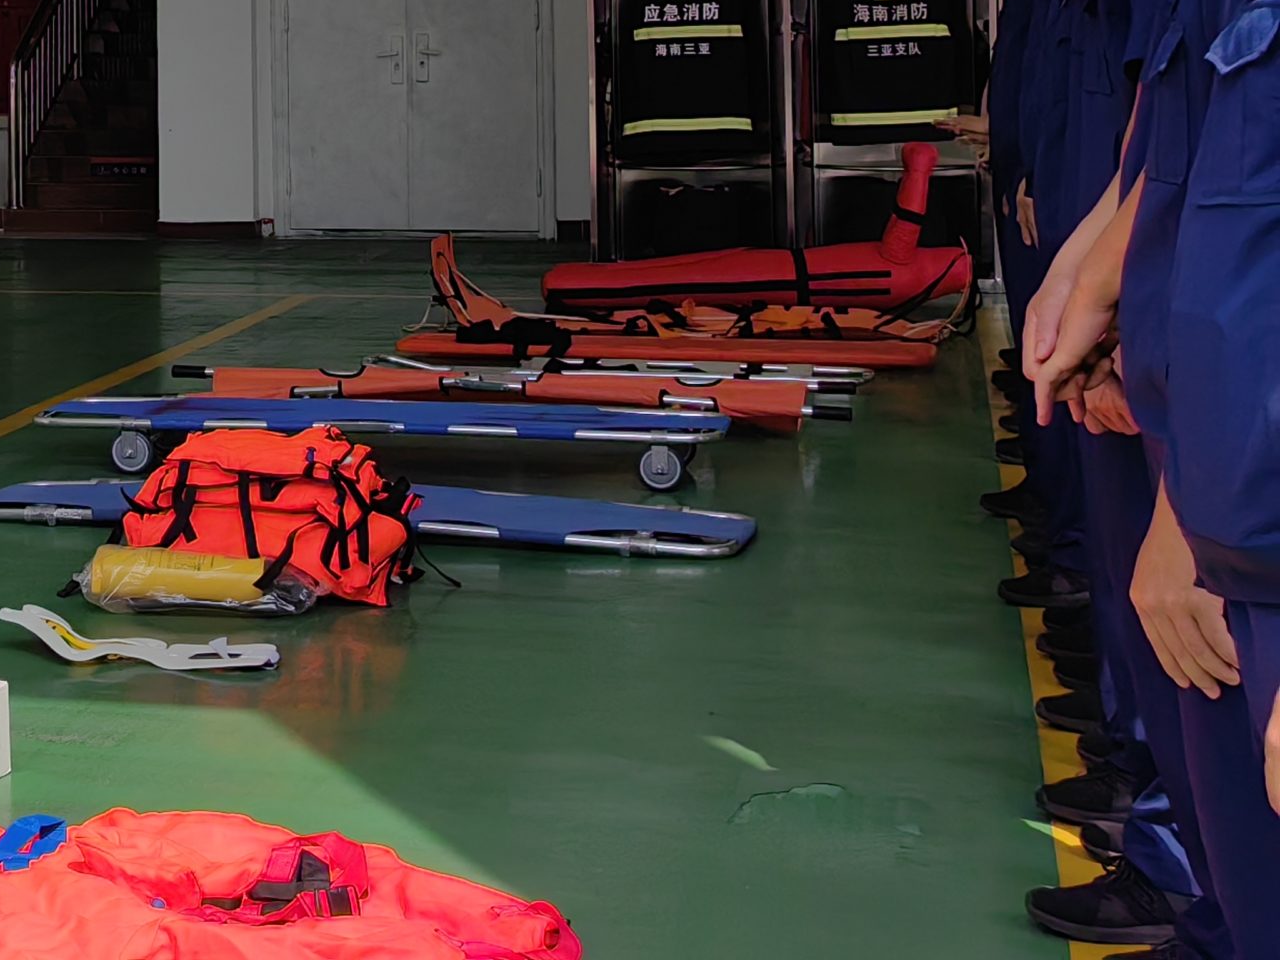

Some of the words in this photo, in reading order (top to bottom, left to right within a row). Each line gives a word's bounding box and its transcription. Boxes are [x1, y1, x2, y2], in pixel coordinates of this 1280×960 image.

[643, 1, 720, 23] 应急消防
[853, 1, 928, 23] 海南消防
[655, 42, 711, 57] 海南三亚
[866, 41, 922, 57] 三亚支队
